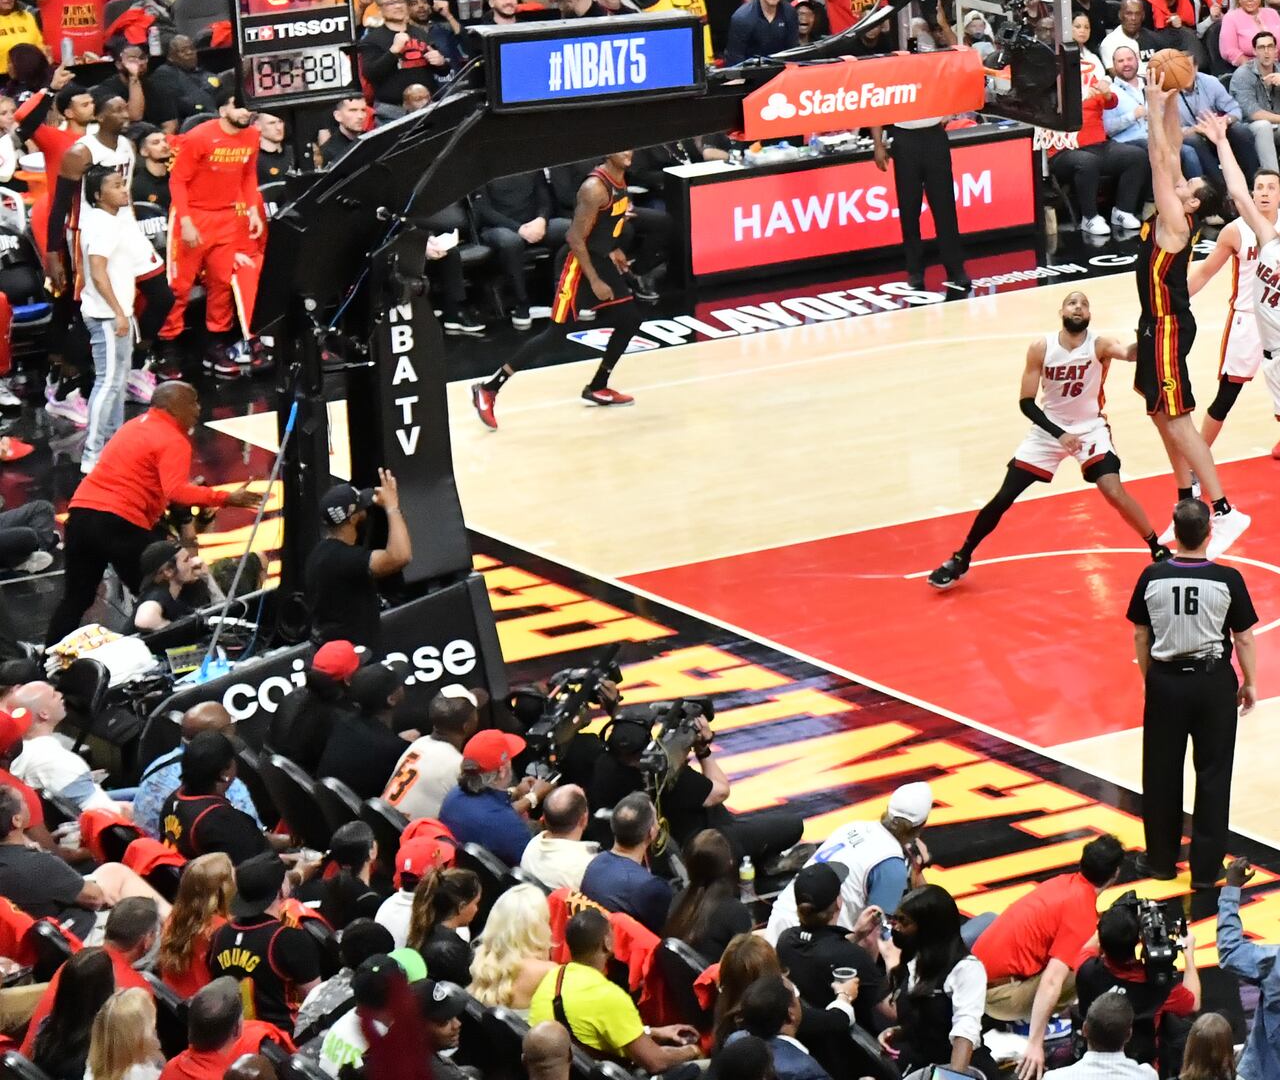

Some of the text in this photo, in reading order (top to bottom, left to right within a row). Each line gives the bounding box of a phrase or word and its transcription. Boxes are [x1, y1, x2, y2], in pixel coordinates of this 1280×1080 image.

[273, 16, 349, 40] TISSOT
[548, 37, 647, 91] #NBA75
[798, 82, 916, 118] State Farm
[733, 170, 992, 242] HAWKS.M
[1050, 260, 1088, 277] by
[1259, 286, 1280, 308] 14
[1044, 360, 1093, 381] HEAT
[1060, 381, 1085, 398] 16
[394, 395, 422, 456] TV
[1170, 585, 1199, 616] 16
[217, 947, 262, 973] YOUNG
